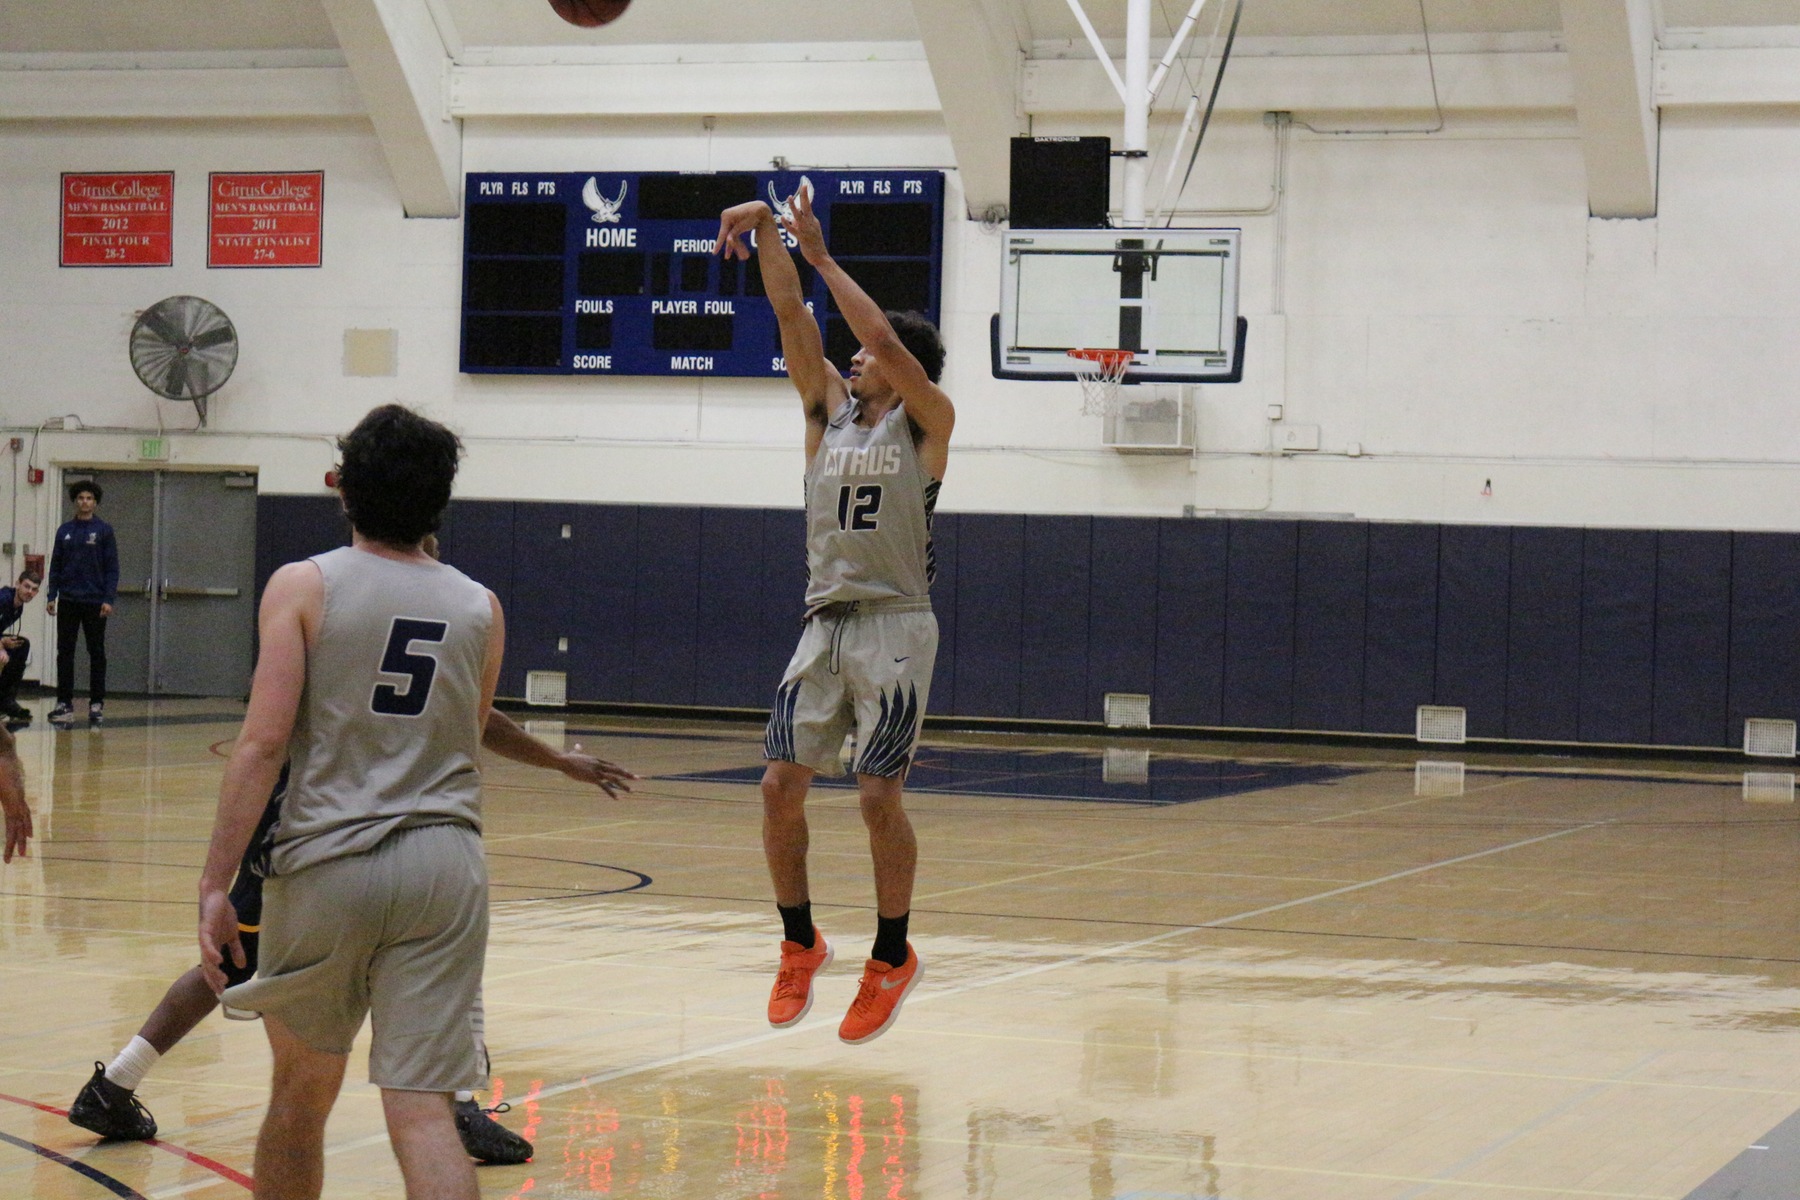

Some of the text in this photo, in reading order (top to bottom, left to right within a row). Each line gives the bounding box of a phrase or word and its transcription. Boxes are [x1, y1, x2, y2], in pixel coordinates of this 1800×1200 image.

[480, 181, 556, 196] PLYR FLS PTS
[840, 180, 923, 194] PLYR FLS PTS
[100, 202, 167, 211] BASKETBALL
[249, 202, 316, 211] BASKETBALL
[102, 218, 129, 230] 2012
[252, 218, 277, 230] 2011
[82, 236, 150, 246] FINAL FOUR
[218, 237, 311, 247] STATE FINALIST
[586, 228, 637, 248] HOME
[673, 238, 716, 253] PERIOD
[575, 300, 614, 314] FOULS
[651, 300, 736, 315] PLAYER FOUL
[573, 355, 612, 369] SCORE
[670, 356, 714, 370] MATCH
[823, 444, 902, 476] CITRUS
[837, 483, 883, 532] 12
[370, 617, 449, 717] 5
